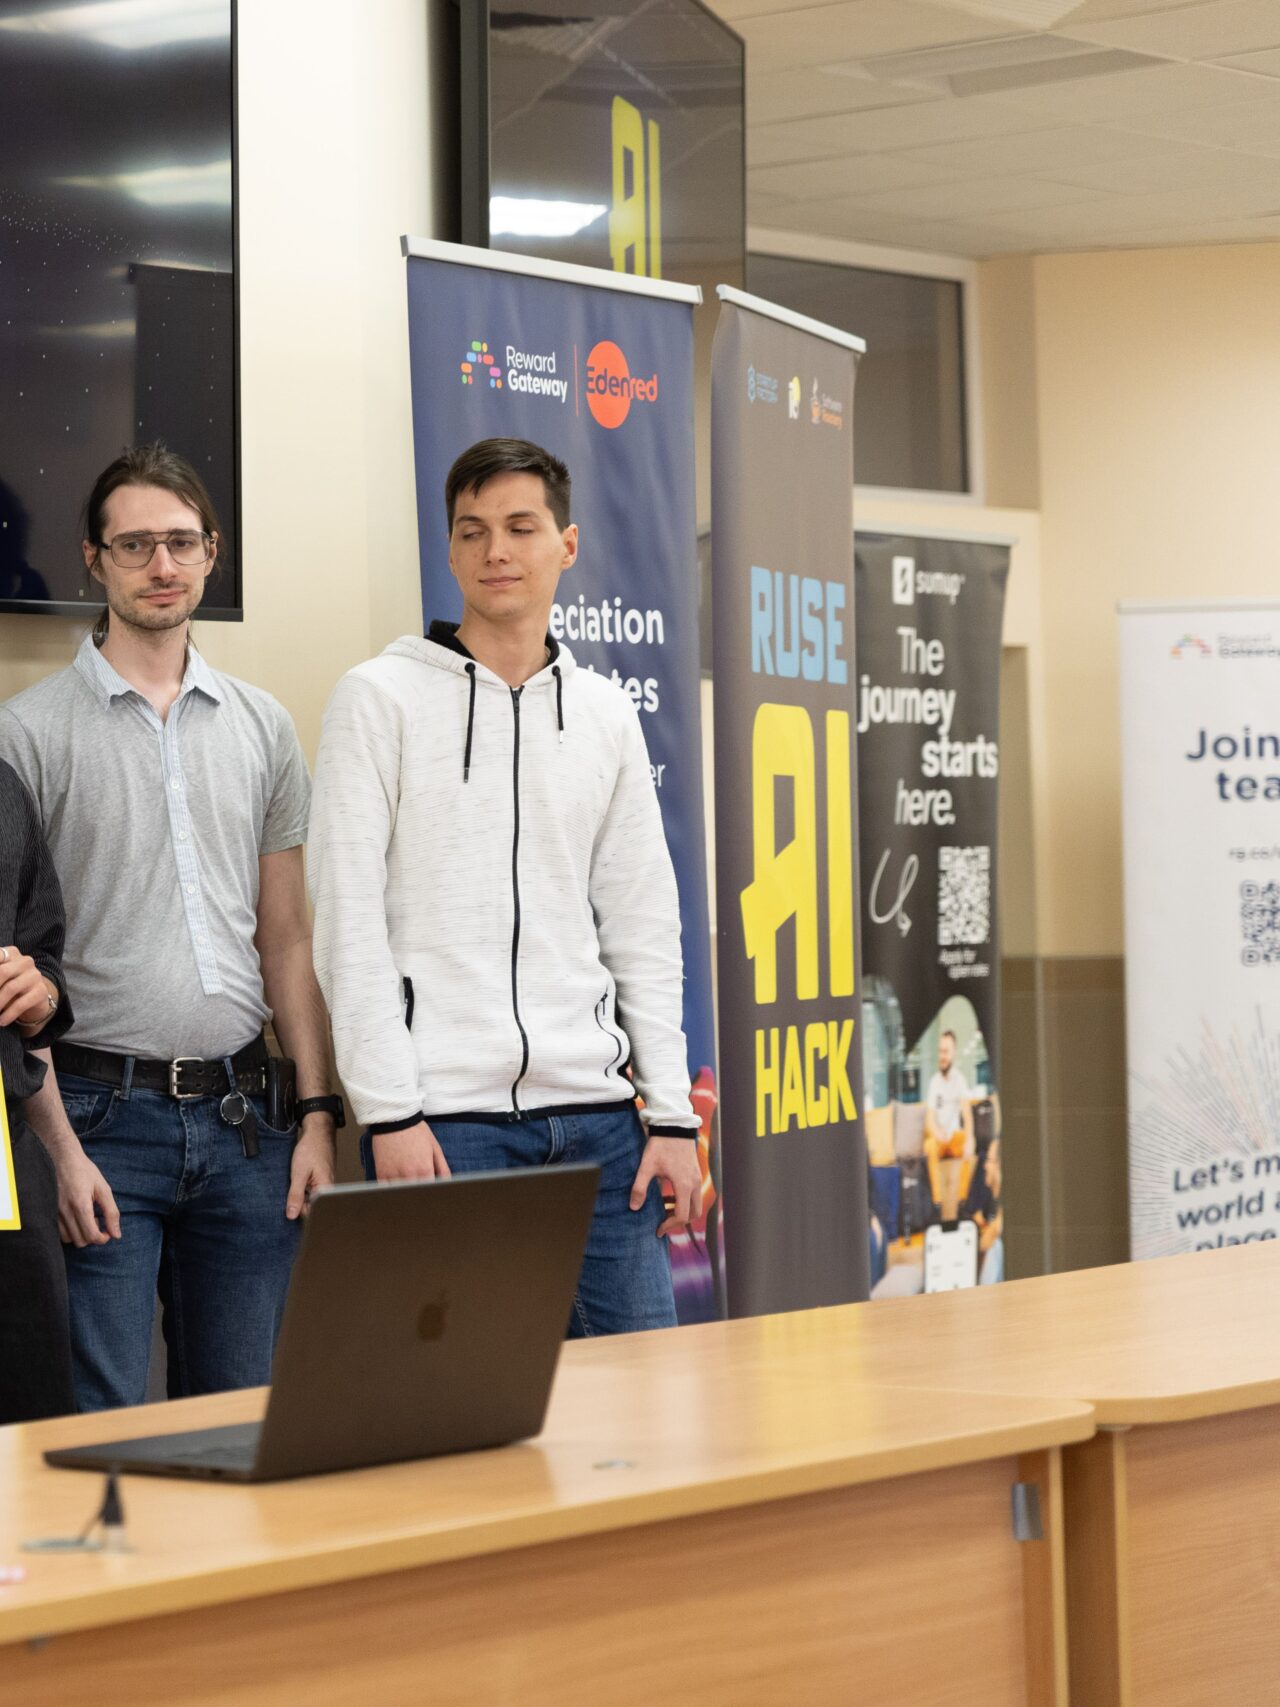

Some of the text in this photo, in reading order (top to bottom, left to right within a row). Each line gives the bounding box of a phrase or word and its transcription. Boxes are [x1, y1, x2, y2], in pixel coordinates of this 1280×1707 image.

[608, 95, 662, 280] AI
[506, 345, 556, 373] Reward
[507, 368, 568, 403] Gateway
[586, 366, 658, 402] Edenred
[916, 570, 962, 605] sumup
[750, 565, 848, 685] RUSE
[896, 626, 945, 676] The
[858, 674, 957, 736] journey
[921, 734, 999, 778] starts
[1186, 725, 1280, 761] Join
[894, 778, 956, 826] here.
[1216, 771, 1280, 801] tea
[740, 703, 855, 1004] AI
[755, 1019, 858, 1137] HACK
[1173, 1159, 1244, 1192] Let's
[1177, 1188, 1265, 1228] world
